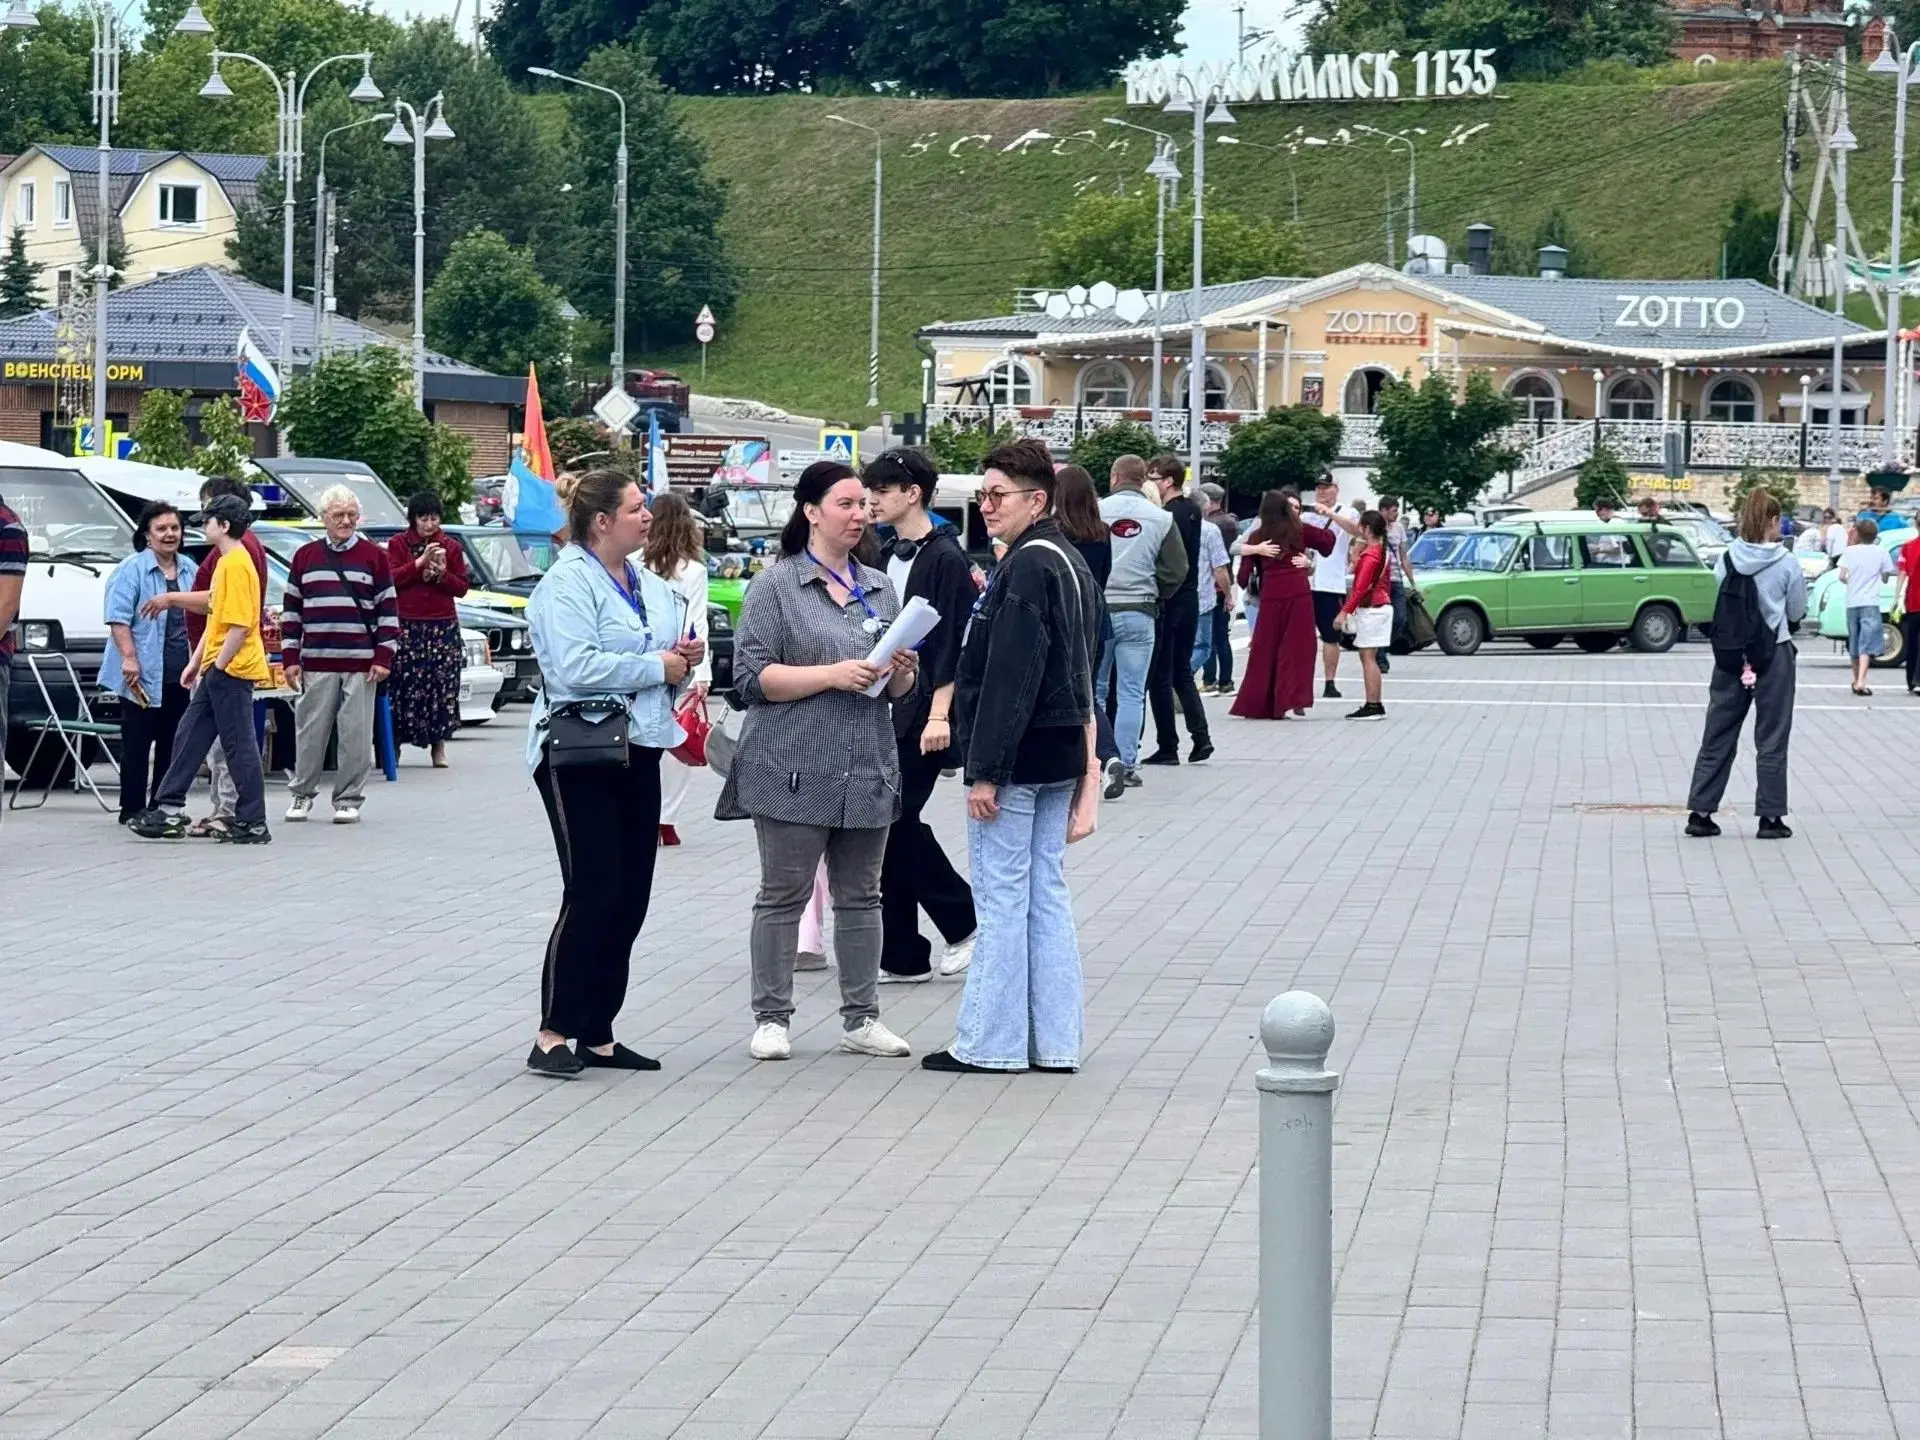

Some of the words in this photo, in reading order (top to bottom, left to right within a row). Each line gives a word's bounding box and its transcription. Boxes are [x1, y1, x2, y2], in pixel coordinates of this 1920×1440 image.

[1412, 47, 1497, 97] 1135
[1325, 310, 1417, 334] ZOTTO
[1615, 294, 1746, 329] ZOTTO
[4, 362, 144, 381] ВОЕНСПЕЦОРМ
